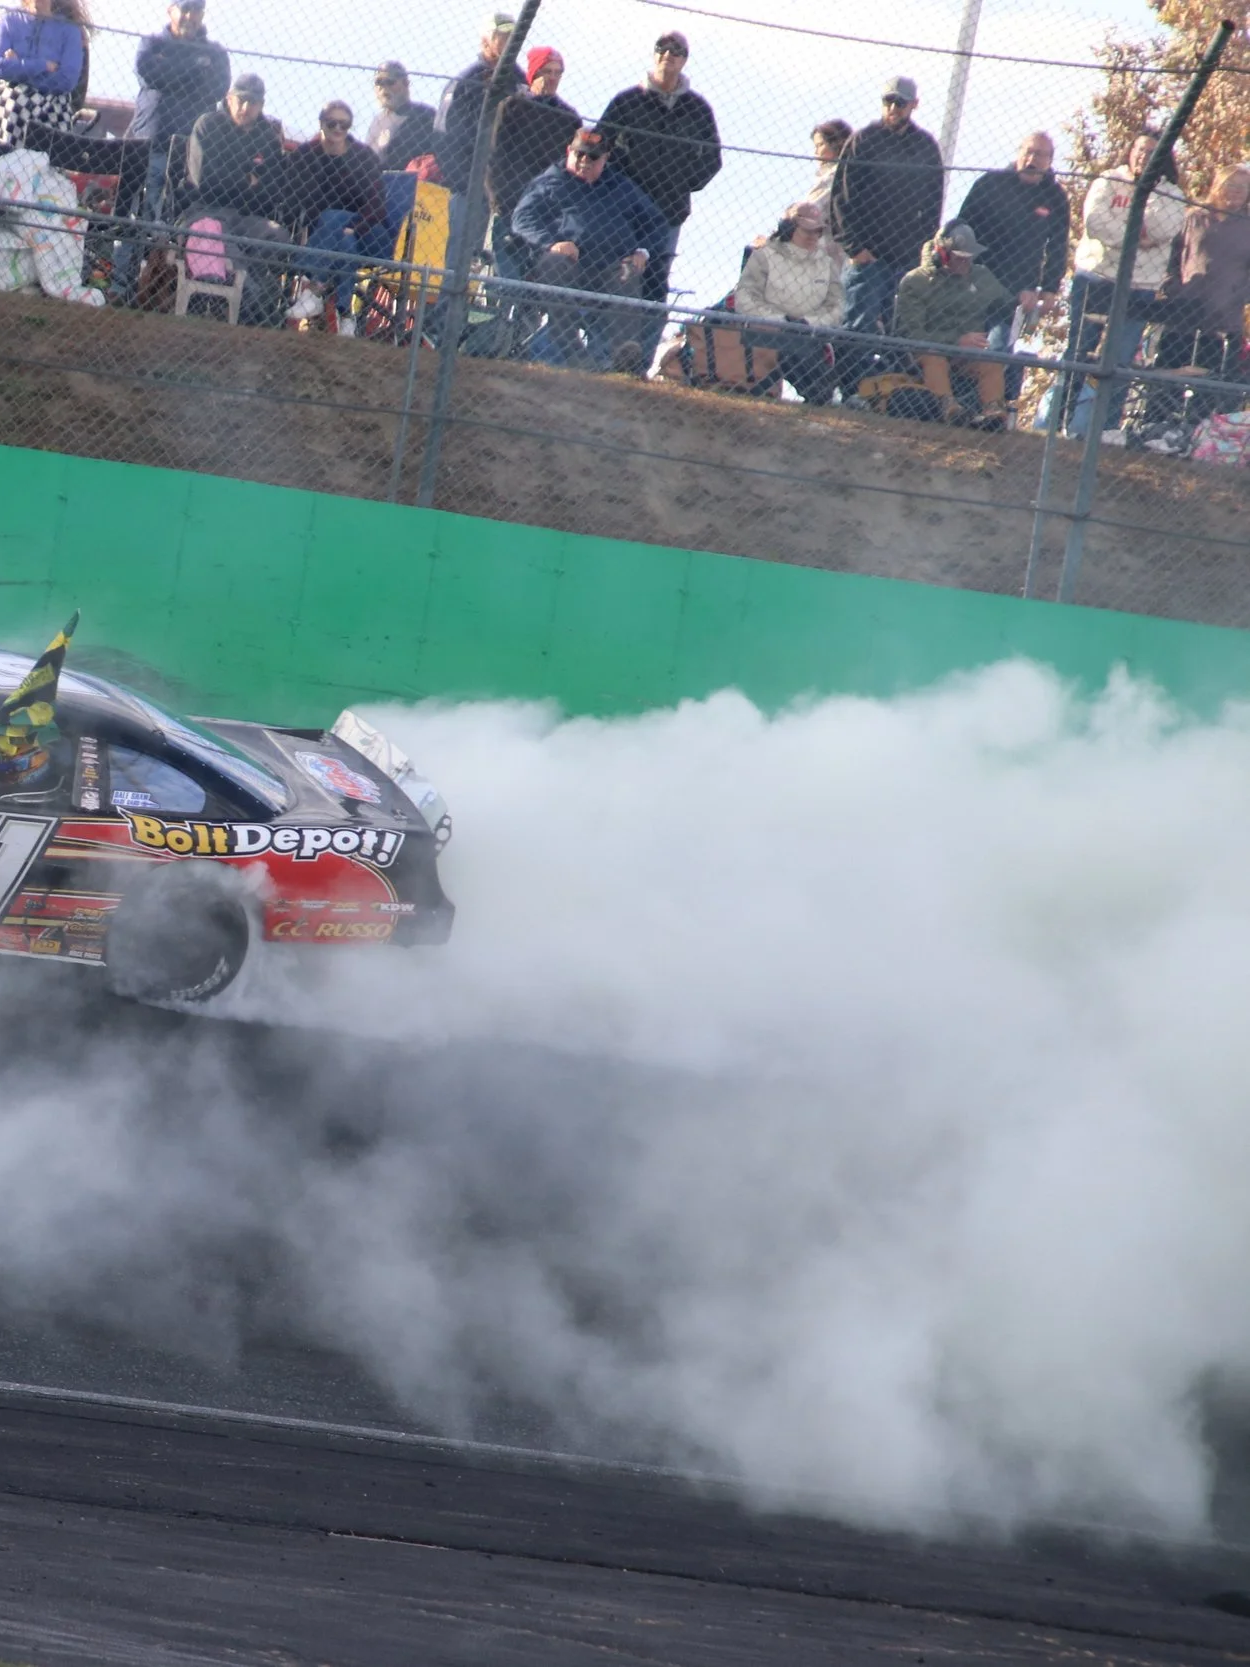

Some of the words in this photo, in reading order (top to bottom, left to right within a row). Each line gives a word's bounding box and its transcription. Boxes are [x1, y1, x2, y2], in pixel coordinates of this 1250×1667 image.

[130, 814, 229, 853] Bolt
[232, 824, 400, 864] Depot!
[380, 903, 416, 912] KDW
[315, 923, 394, 937] RUSSO
